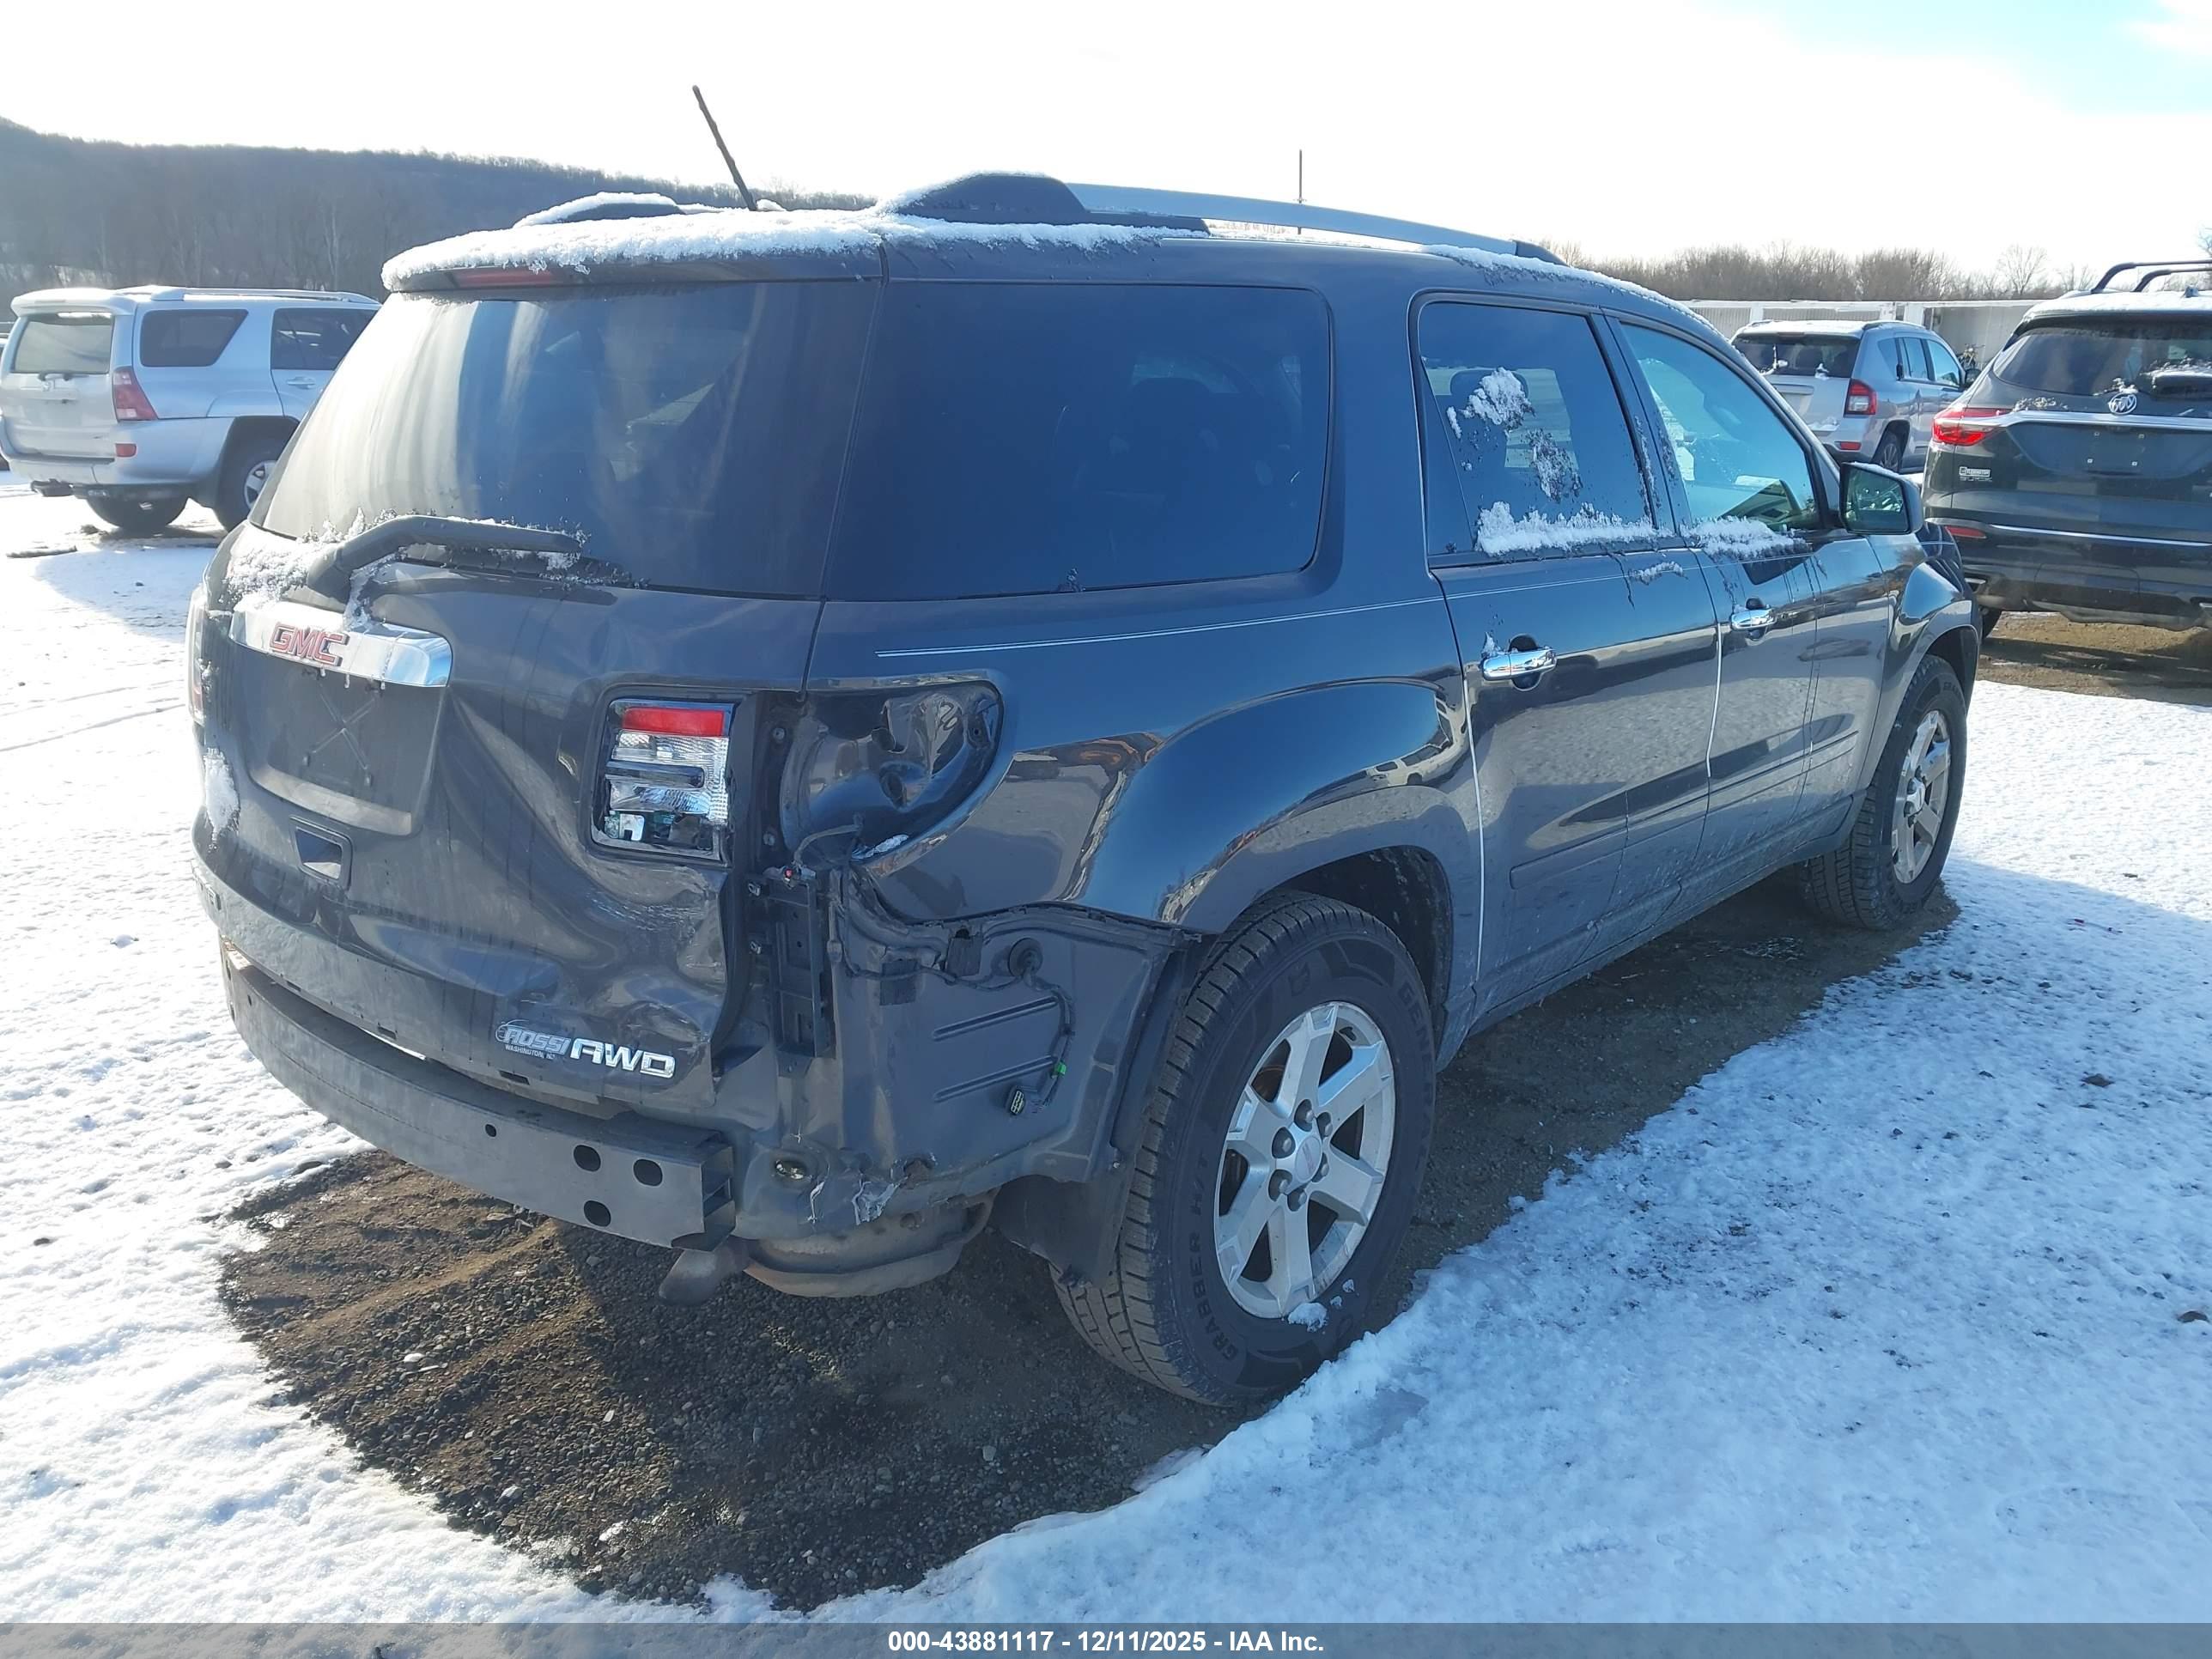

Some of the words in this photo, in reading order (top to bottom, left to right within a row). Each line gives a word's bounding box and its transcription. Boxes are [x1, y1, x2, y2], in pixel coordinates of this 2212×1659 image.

[270, 623, 349, 666] GMC
[503, 1027, 572, 1055] ROSSI
[570, 1038, 675, 1079] AWD
[1188, 1231, 1238, 1360] GRABBER
